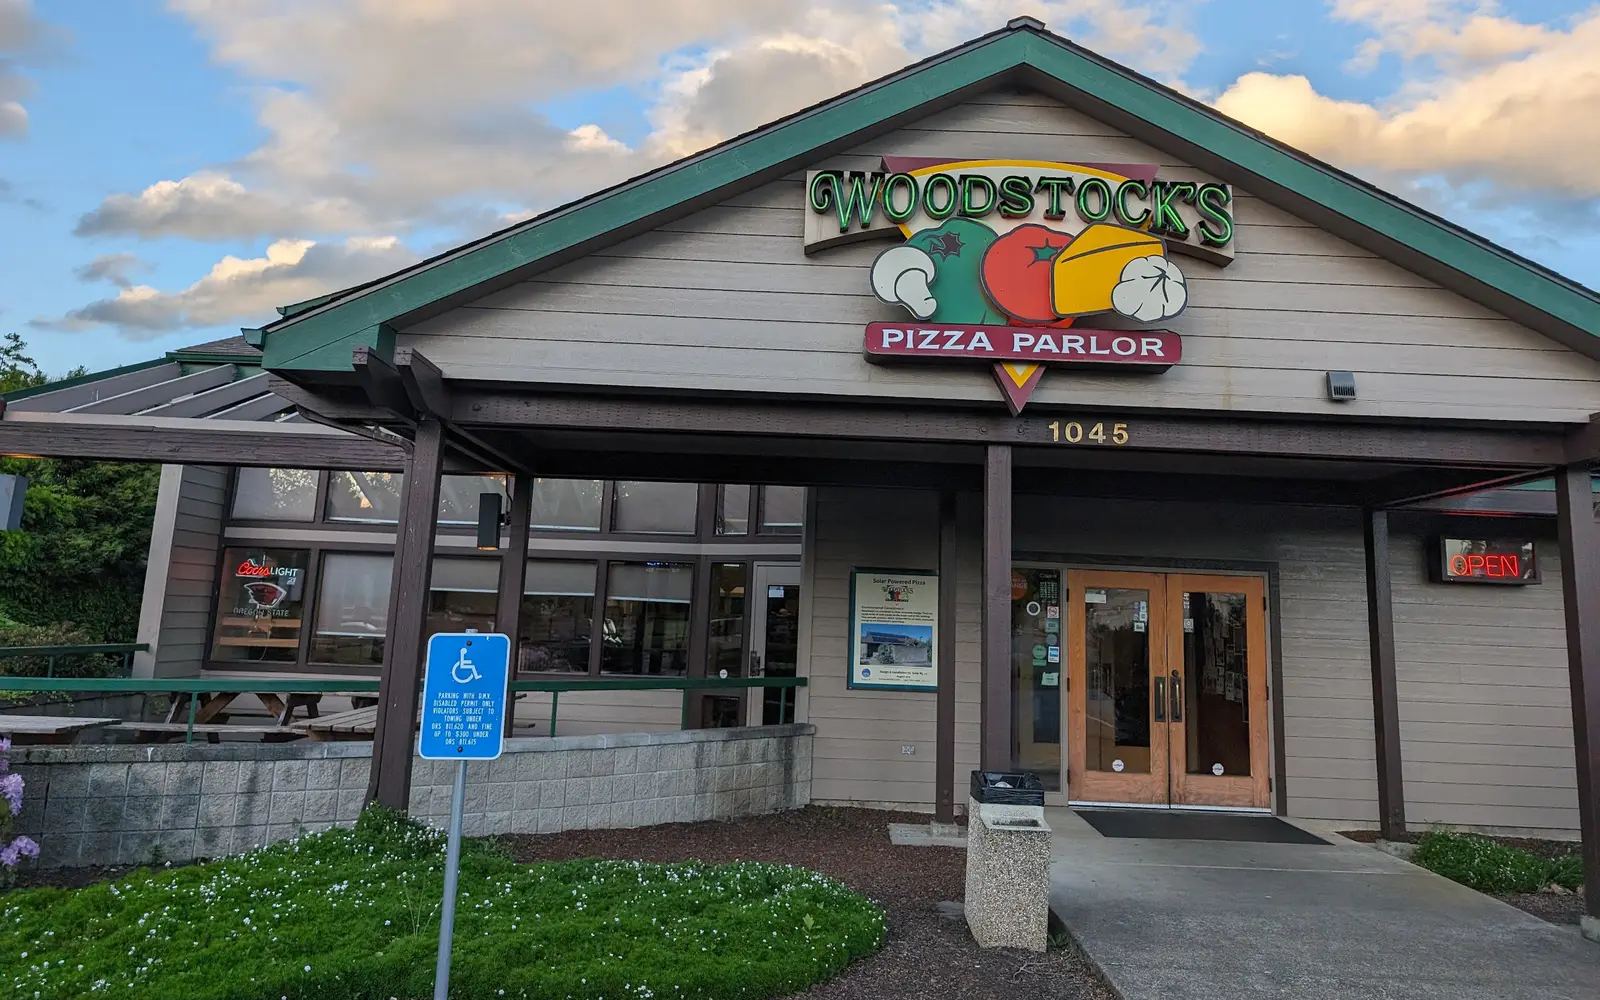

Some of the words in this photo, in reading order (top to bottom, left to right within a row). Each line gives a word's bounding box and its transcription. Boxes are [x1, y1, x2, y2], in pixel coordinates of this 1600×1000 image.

[809, 170, 1233, 248] WOODSTOCK'S
[882, 328, 993, 352] PIZZA
[1012, 332, 1165, 357] PARLOR
[1048, 420, 1130, 444] 1045
[238, 562, 270, 576] Coors
[270, 567, 298, 576] LIGHT
[1451, 555, 1518, 577] OPEN
[234, 608, 264, 616] OREGON
